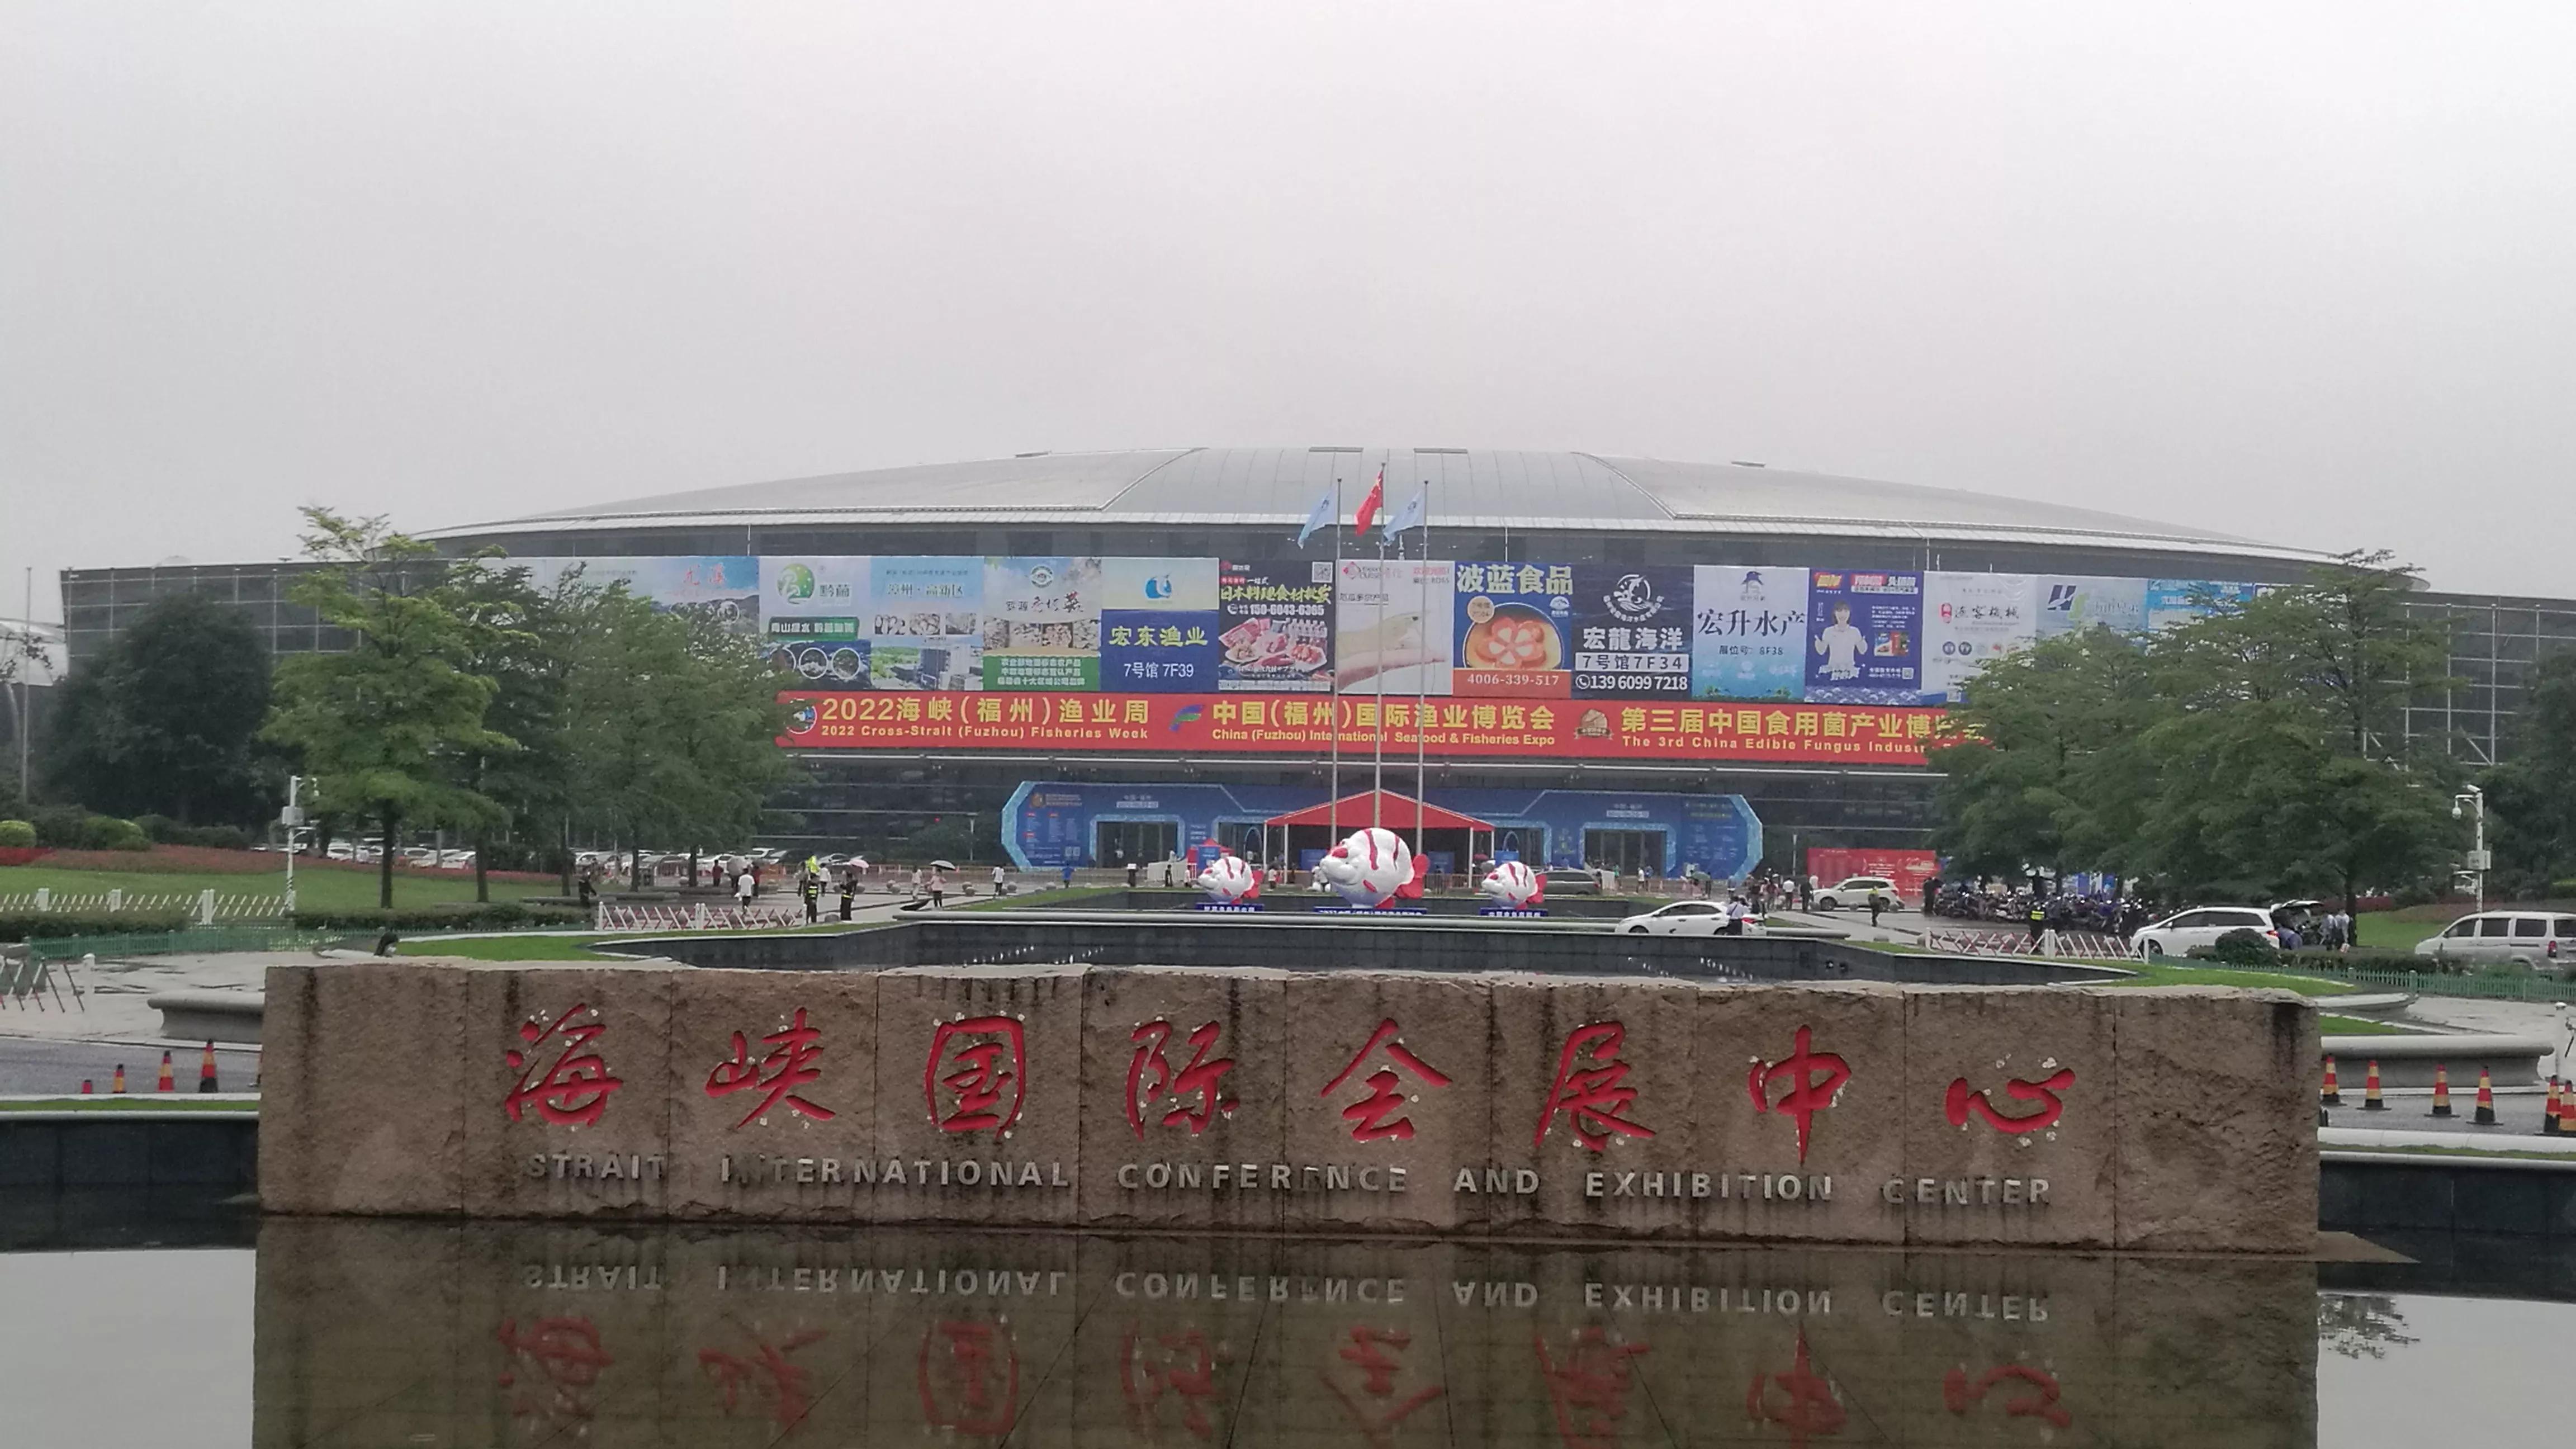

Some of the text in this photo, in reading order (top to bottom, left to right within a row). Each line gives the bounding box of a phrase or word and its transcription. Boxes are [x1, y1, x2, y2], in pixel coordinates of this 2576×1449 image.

[1457, 564, 1574, 595] 波蓝食品
[1697, 608, 1806, 637] 宏升水产
[1109, 626, 1209, 647] 宏东渔业
[1583, 627, 1683, 651] 宏龍海洋
[1124, 663, 1194, 679] 7号馆 7F39
[1467, 673, 1560, 686] 4006-339-517
[1590, 675, 1688, 690] 139 6099 7218
[822, 697, 1148, 724] 2022海峡（福州）渔业周
[1212, 700, 1555, 730] 中国（福州）国际渔业博览会
[822, 726, 1148, 739] 2022 Cross-Strait (Fuzhou) Fisheries Week
[1212, 729, 1555, 747] China (Fuzhou) Intenationl Seaood & Fisheries Expo
[1623, 736, 1926, 754] The 3rd China Edible Fungus Industr
[505, 1004, 2076, 1165] 海峡国际会展中心
[527, 1153, 665, 1180] STRAIT
[721, 1155, 1069, 1187] ITERNATIONAL
[1454, 1167, 1539, 1195] AND
[1586, 1171, 1831, 1201] EXHIBITION
[1882, 1178, 2050, 1206] CENTER
